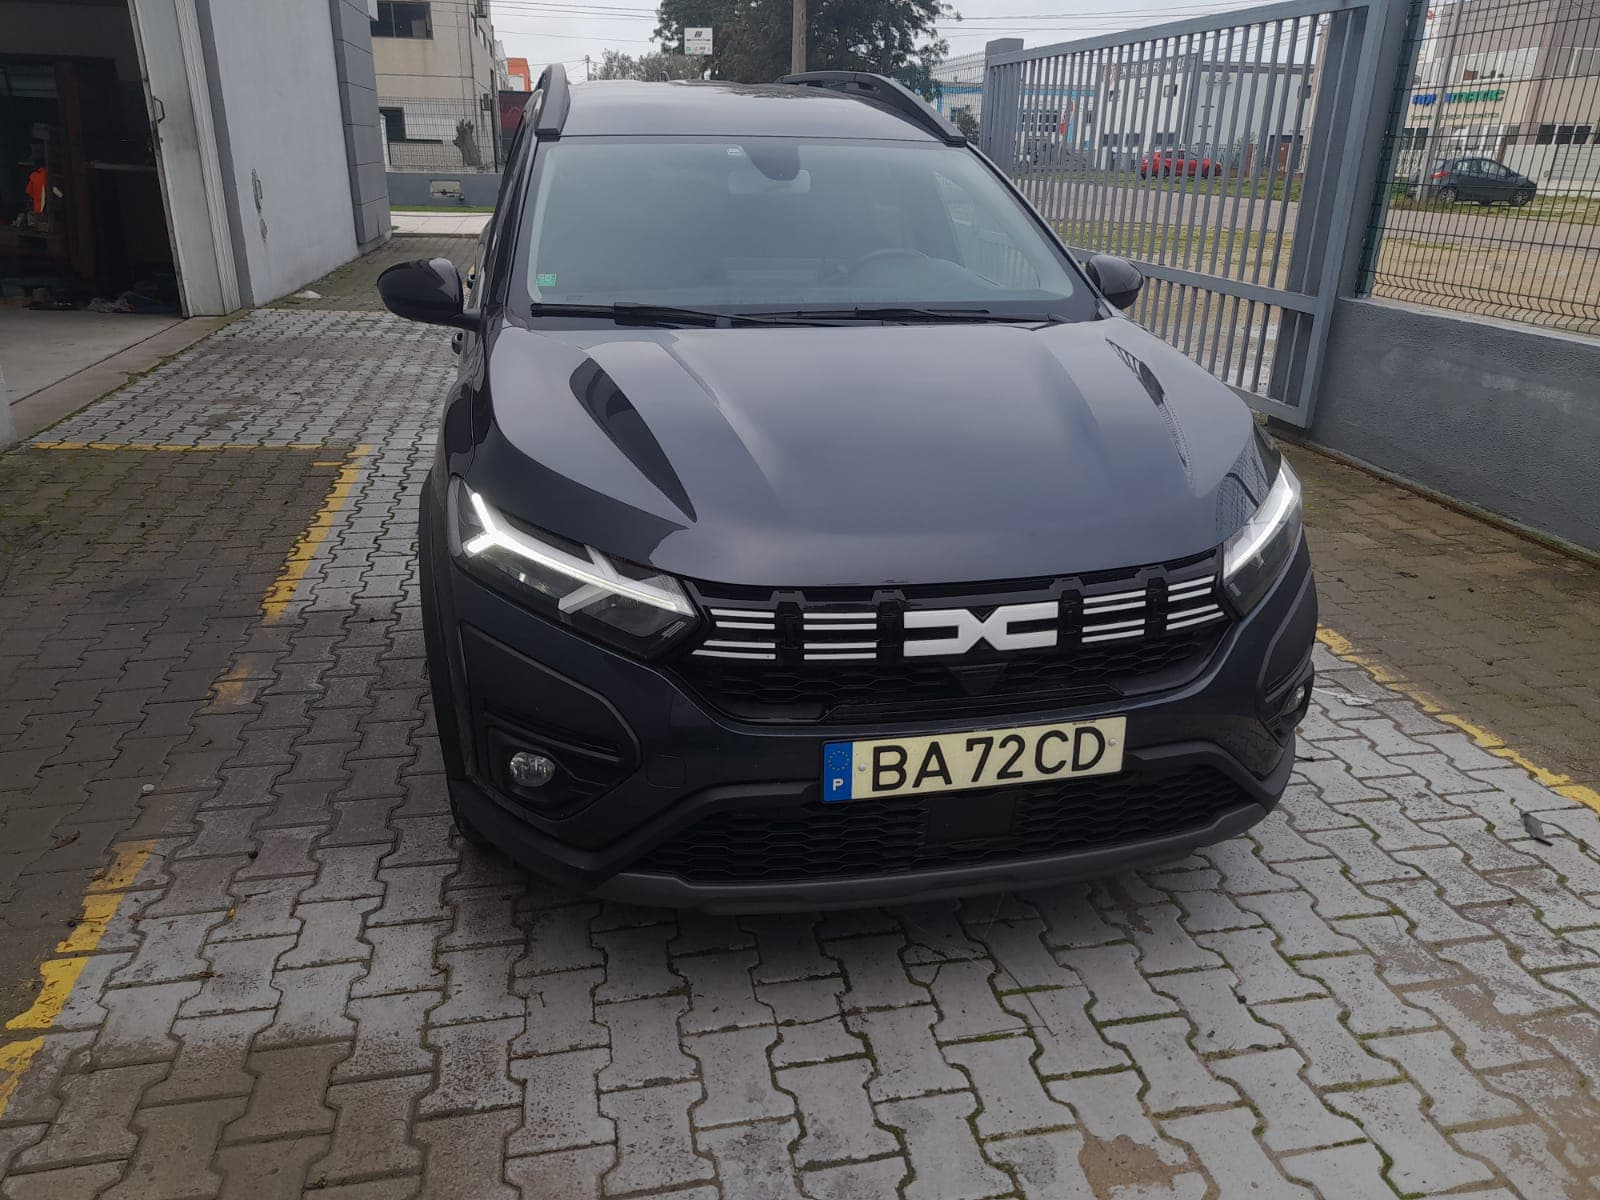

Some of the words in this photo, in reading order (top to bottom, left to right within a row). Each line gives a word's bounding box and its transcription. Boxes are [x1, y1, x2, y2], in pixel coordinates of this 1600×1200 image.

[871, 741, 953, 792] BA
[965, 733, 1027, 783] 72
[1034, 726, 1106, 775] CD
[832, 778, 844, 792] P
